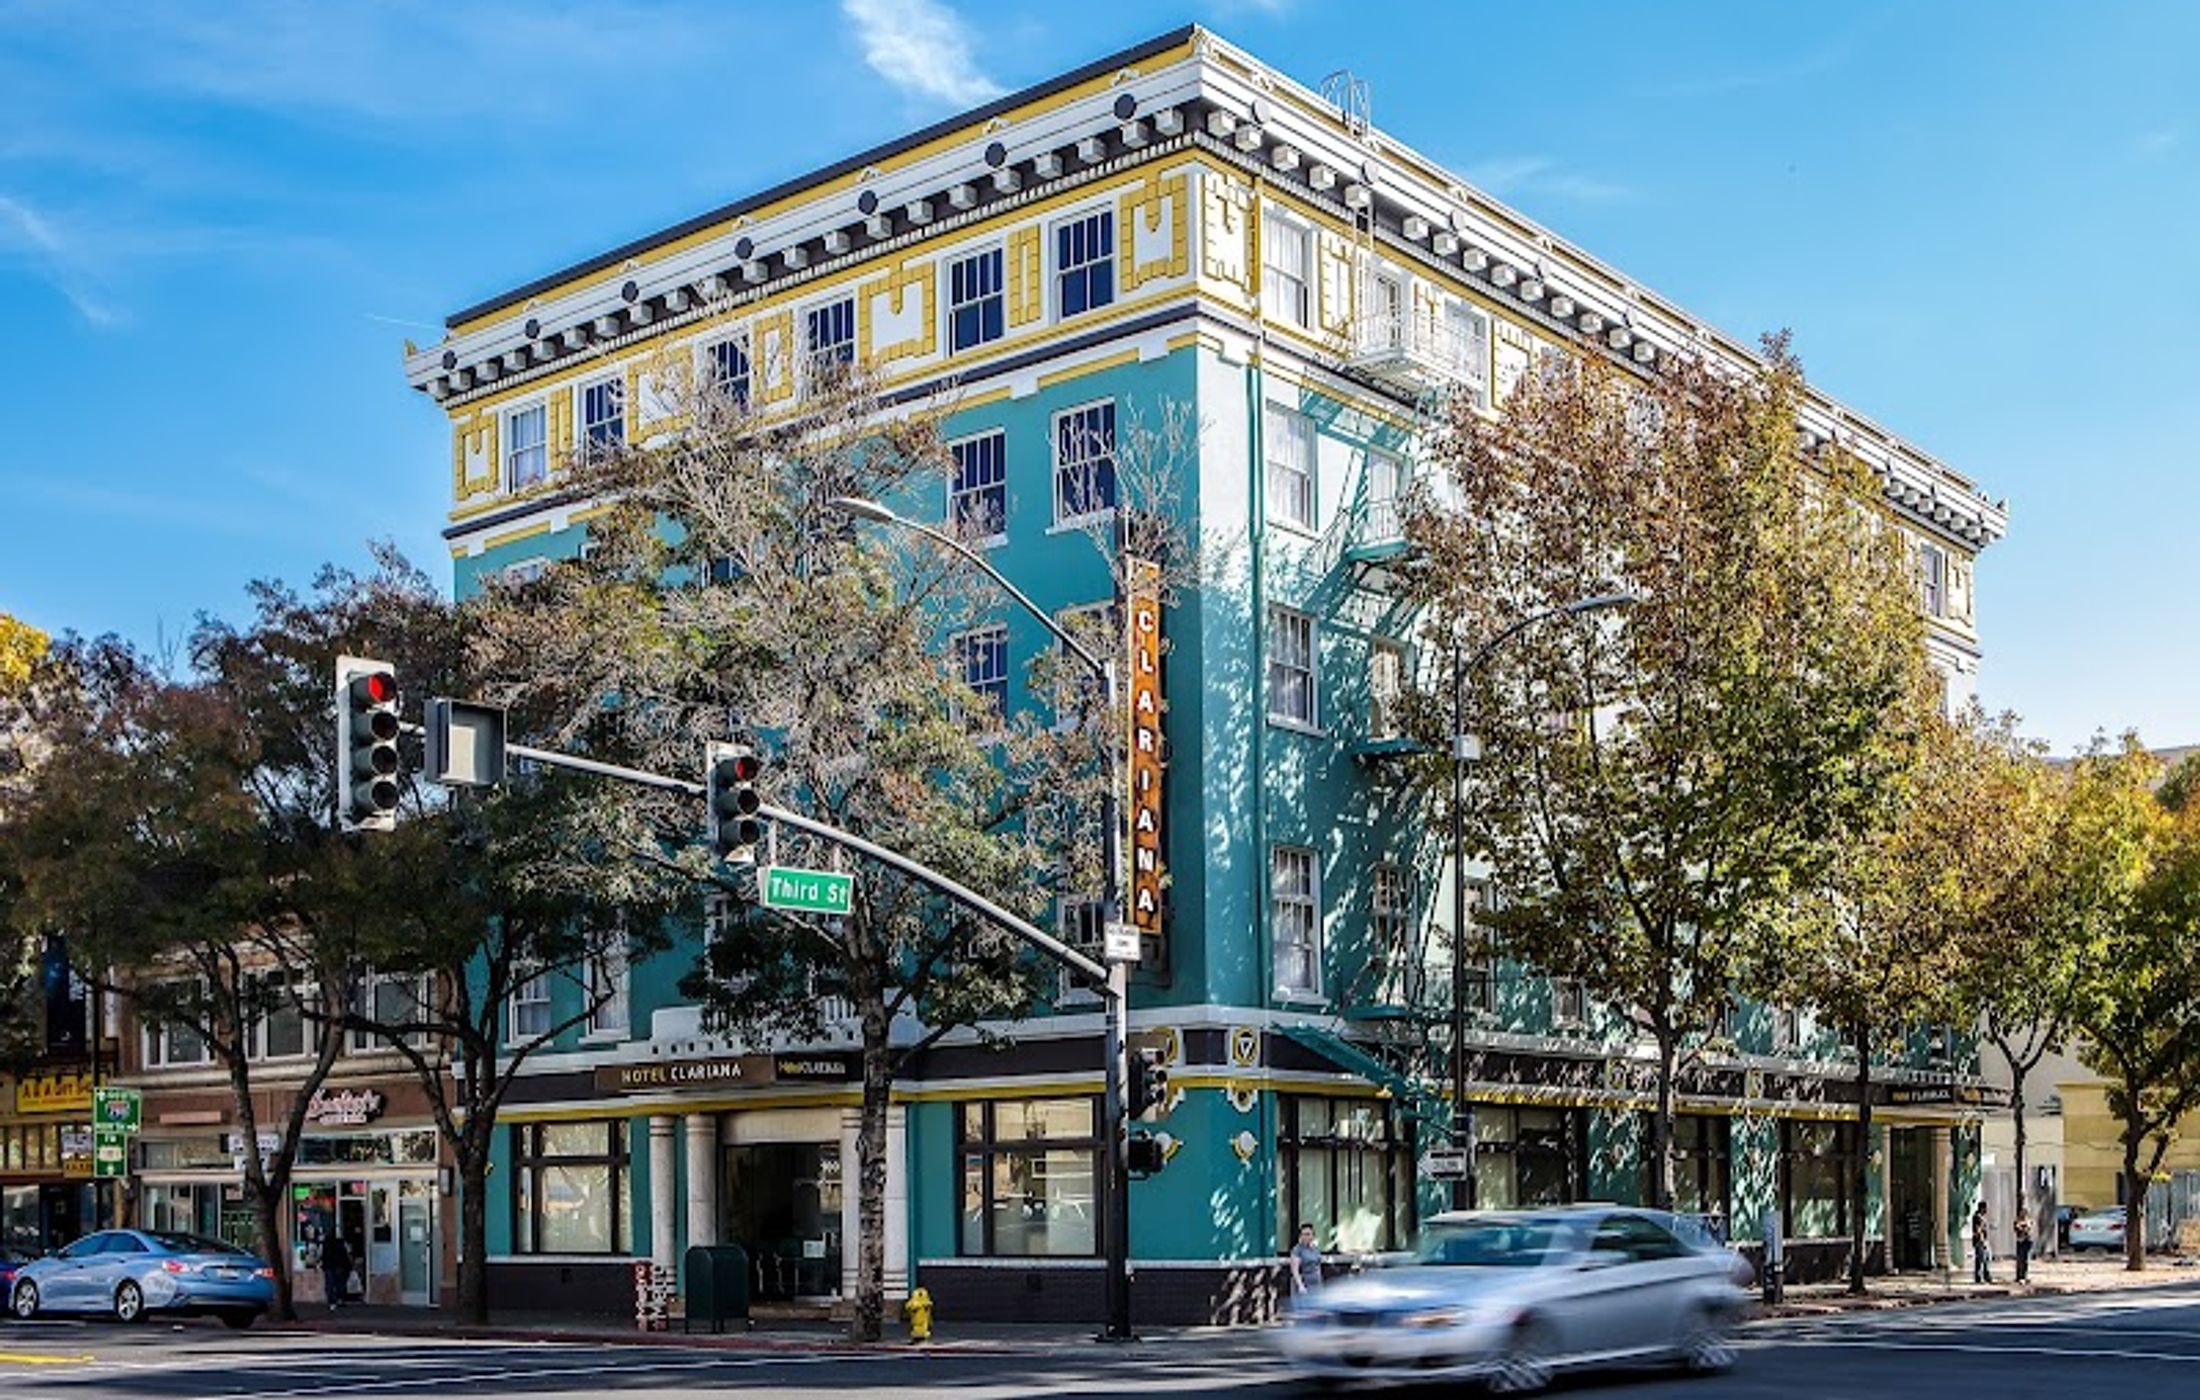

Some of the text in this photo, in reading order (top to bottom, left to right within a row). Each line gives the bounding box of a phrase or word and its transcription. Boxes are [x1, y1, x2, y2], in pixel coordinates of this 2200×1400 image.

[1136, 610, 1154, 913] CLARIANA
[771, 877, 848, 905] Third St
[621, 1062, 742, 1083] HOTEL CLARIANA
